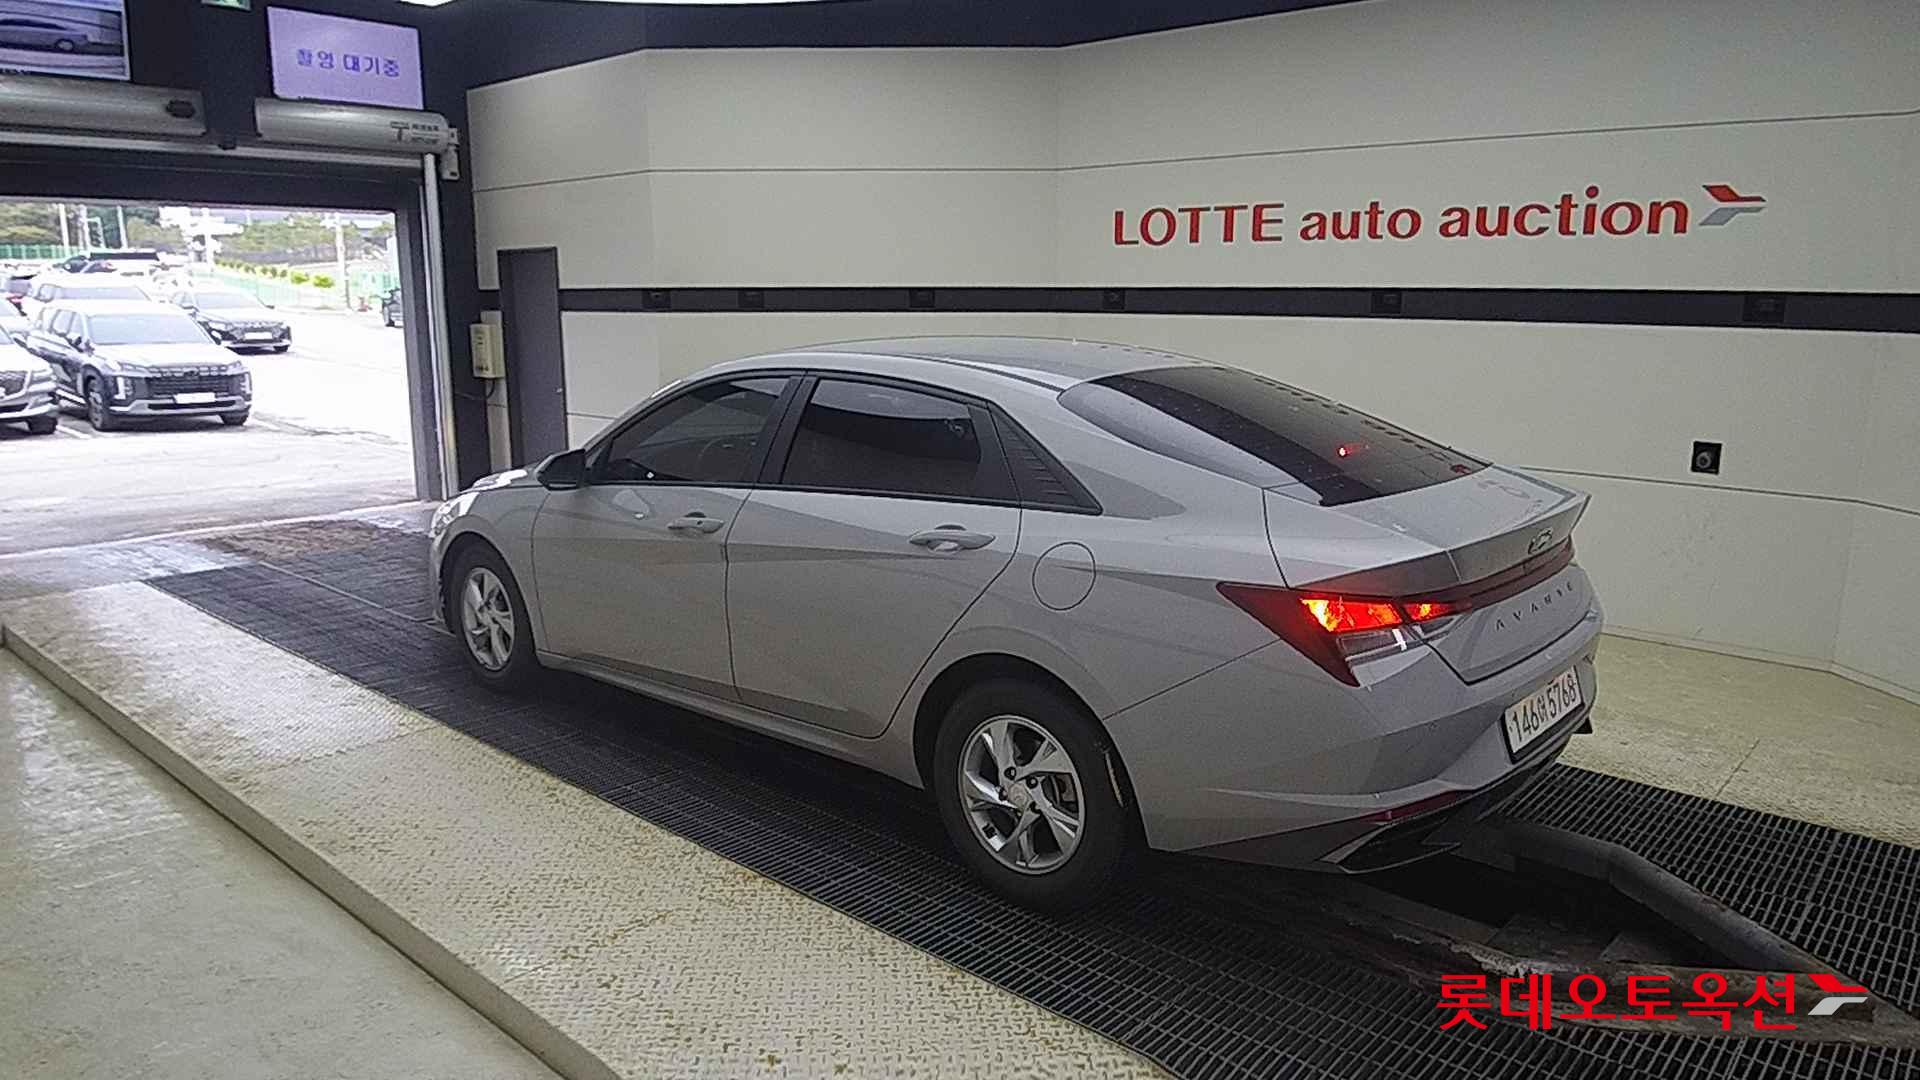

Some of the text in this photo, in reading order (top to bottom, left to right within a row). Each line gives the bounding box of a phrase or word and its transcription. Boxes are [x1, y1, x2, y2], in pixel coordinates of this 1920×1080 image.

[343, 54, 400, 77] 대기중
[1114, 185, 1690, 246] LOTTE auto auction
[1496, 581, 1573, 631] AVANTE
